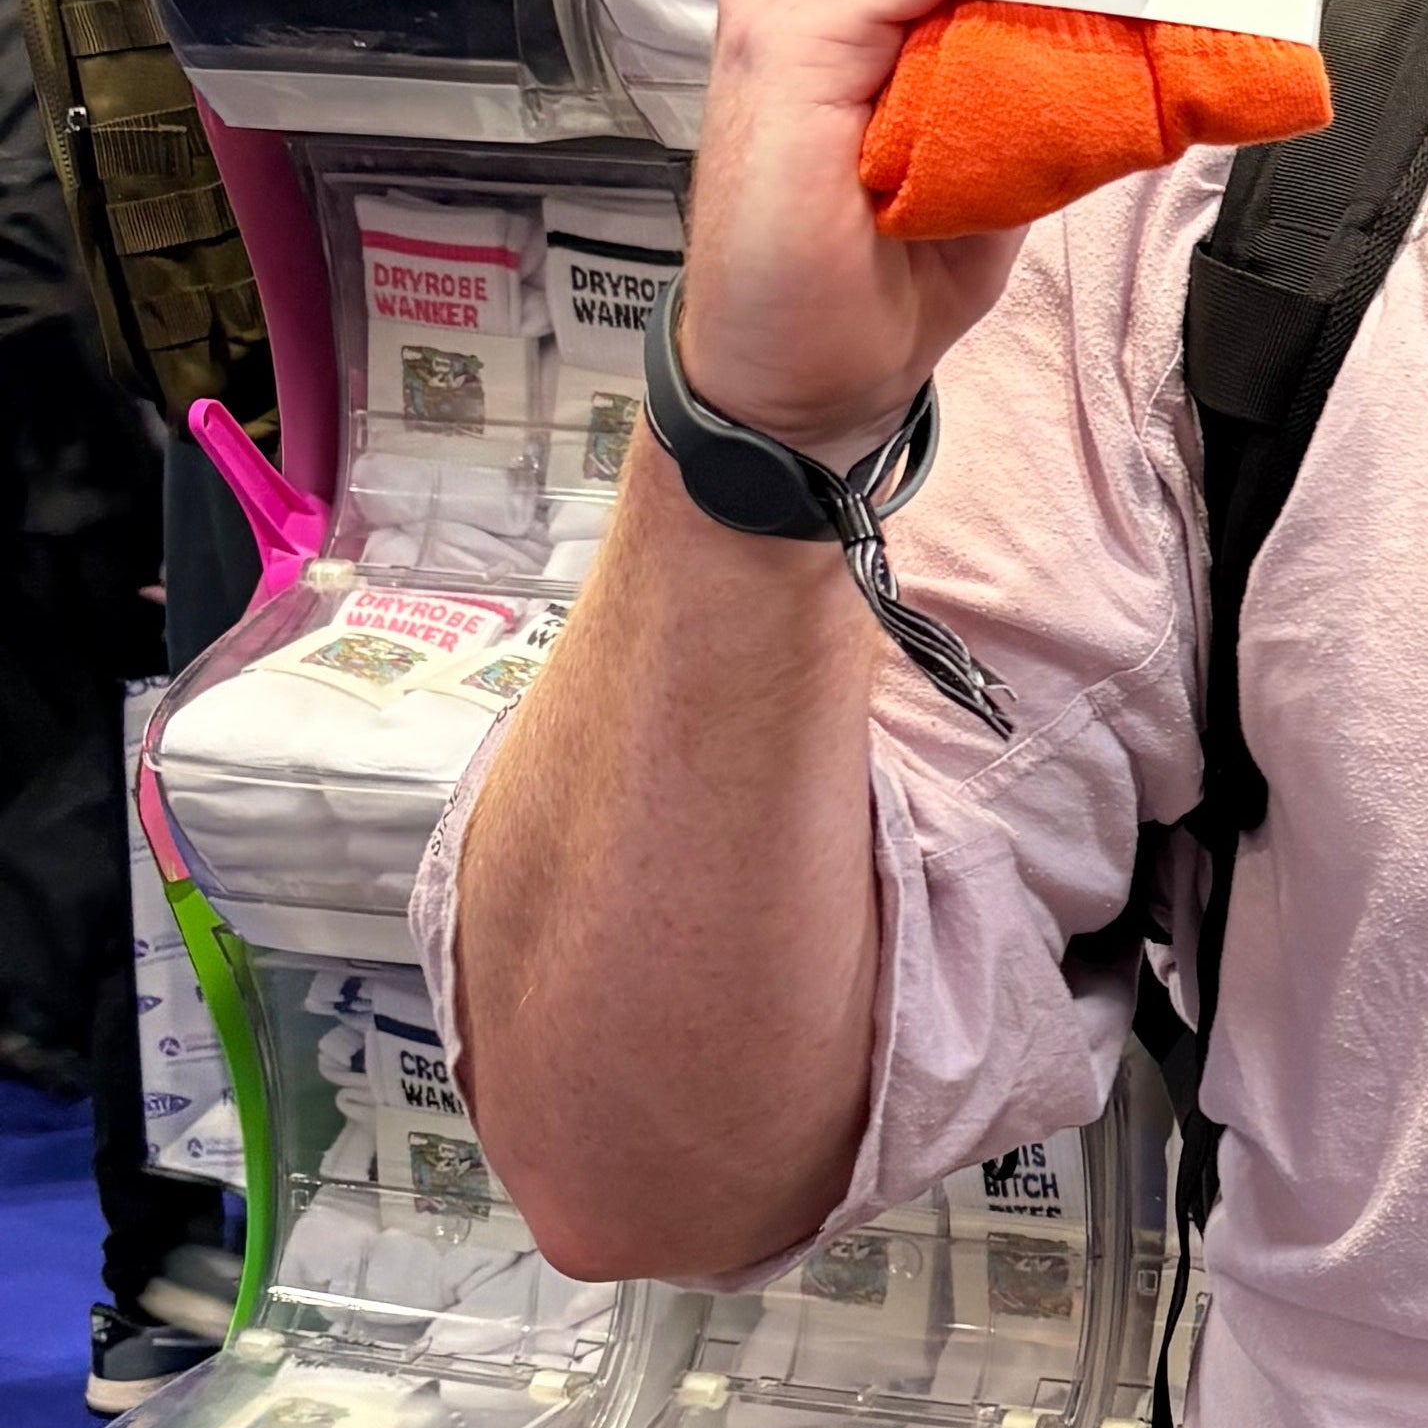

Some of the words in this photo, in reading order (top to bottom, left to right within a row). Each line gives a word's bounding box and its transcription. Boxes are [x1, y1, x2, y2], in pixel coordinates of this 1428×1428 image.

[373, 262, 489, 302] DRYROBE
[374, 292, 479, 329] WANKER
[572, 297, 654, 331] WANK
[345, 610, 461, 653] WANKER
[354, 590, 487, 636] DRYROBE
[400, 1050, 449, 1084] CRO
